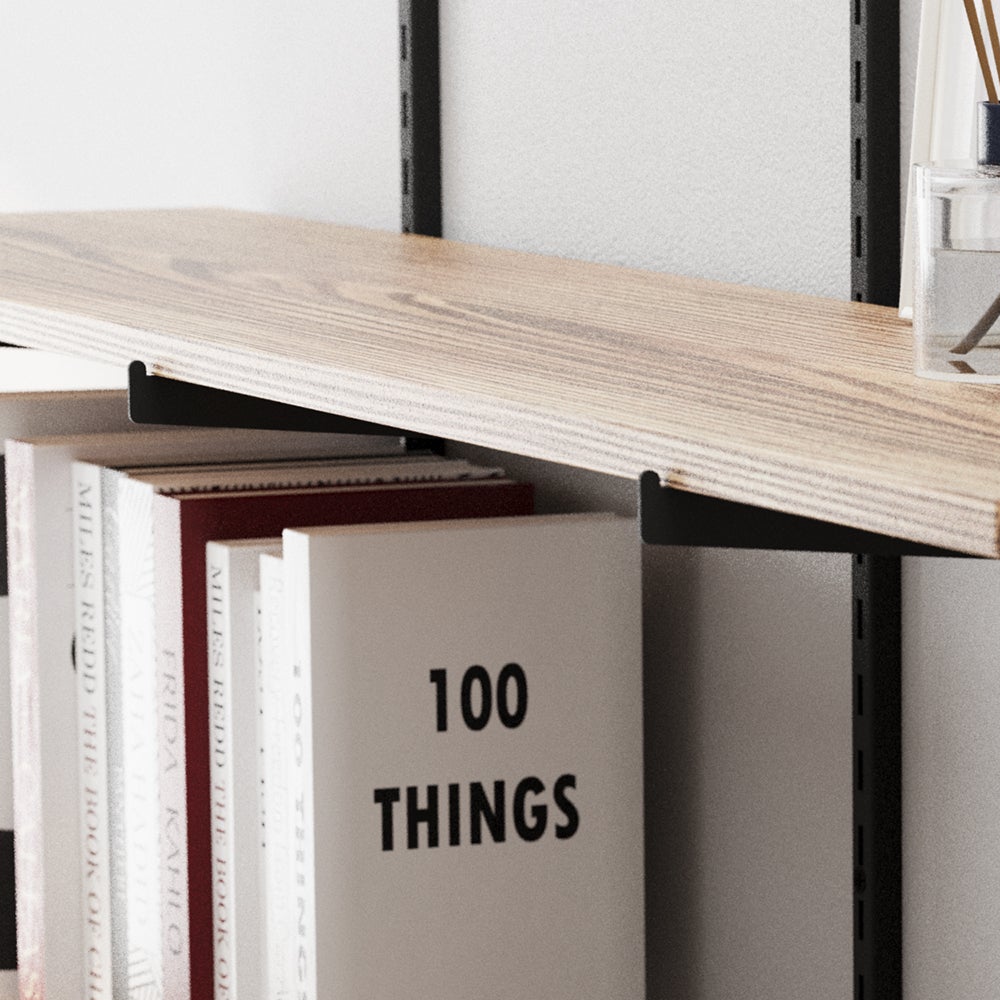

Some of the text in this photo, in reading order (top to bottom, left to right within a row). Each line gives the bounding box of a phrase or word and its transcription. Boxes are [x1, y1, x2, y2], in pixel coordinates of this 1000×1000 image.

[78, 482, 96, 591] MILES
[81, 600, 97, 695] REDD
[210, 564, 224, 668] MILES
[83, 706, 99, 777] THE
[212, 678, 226, 769] REDD
[429, 662, 528, 733] 100
[84, 787, 101, 883] BOOK
[161, 647, 182, 958] FRIDA KAHLO
[214, 780, 228, 847] THE
[373, 773, 580, 852] THINGS
[86, 891, 102, 939] OF
[215, 857, 230, 946] BOOK
